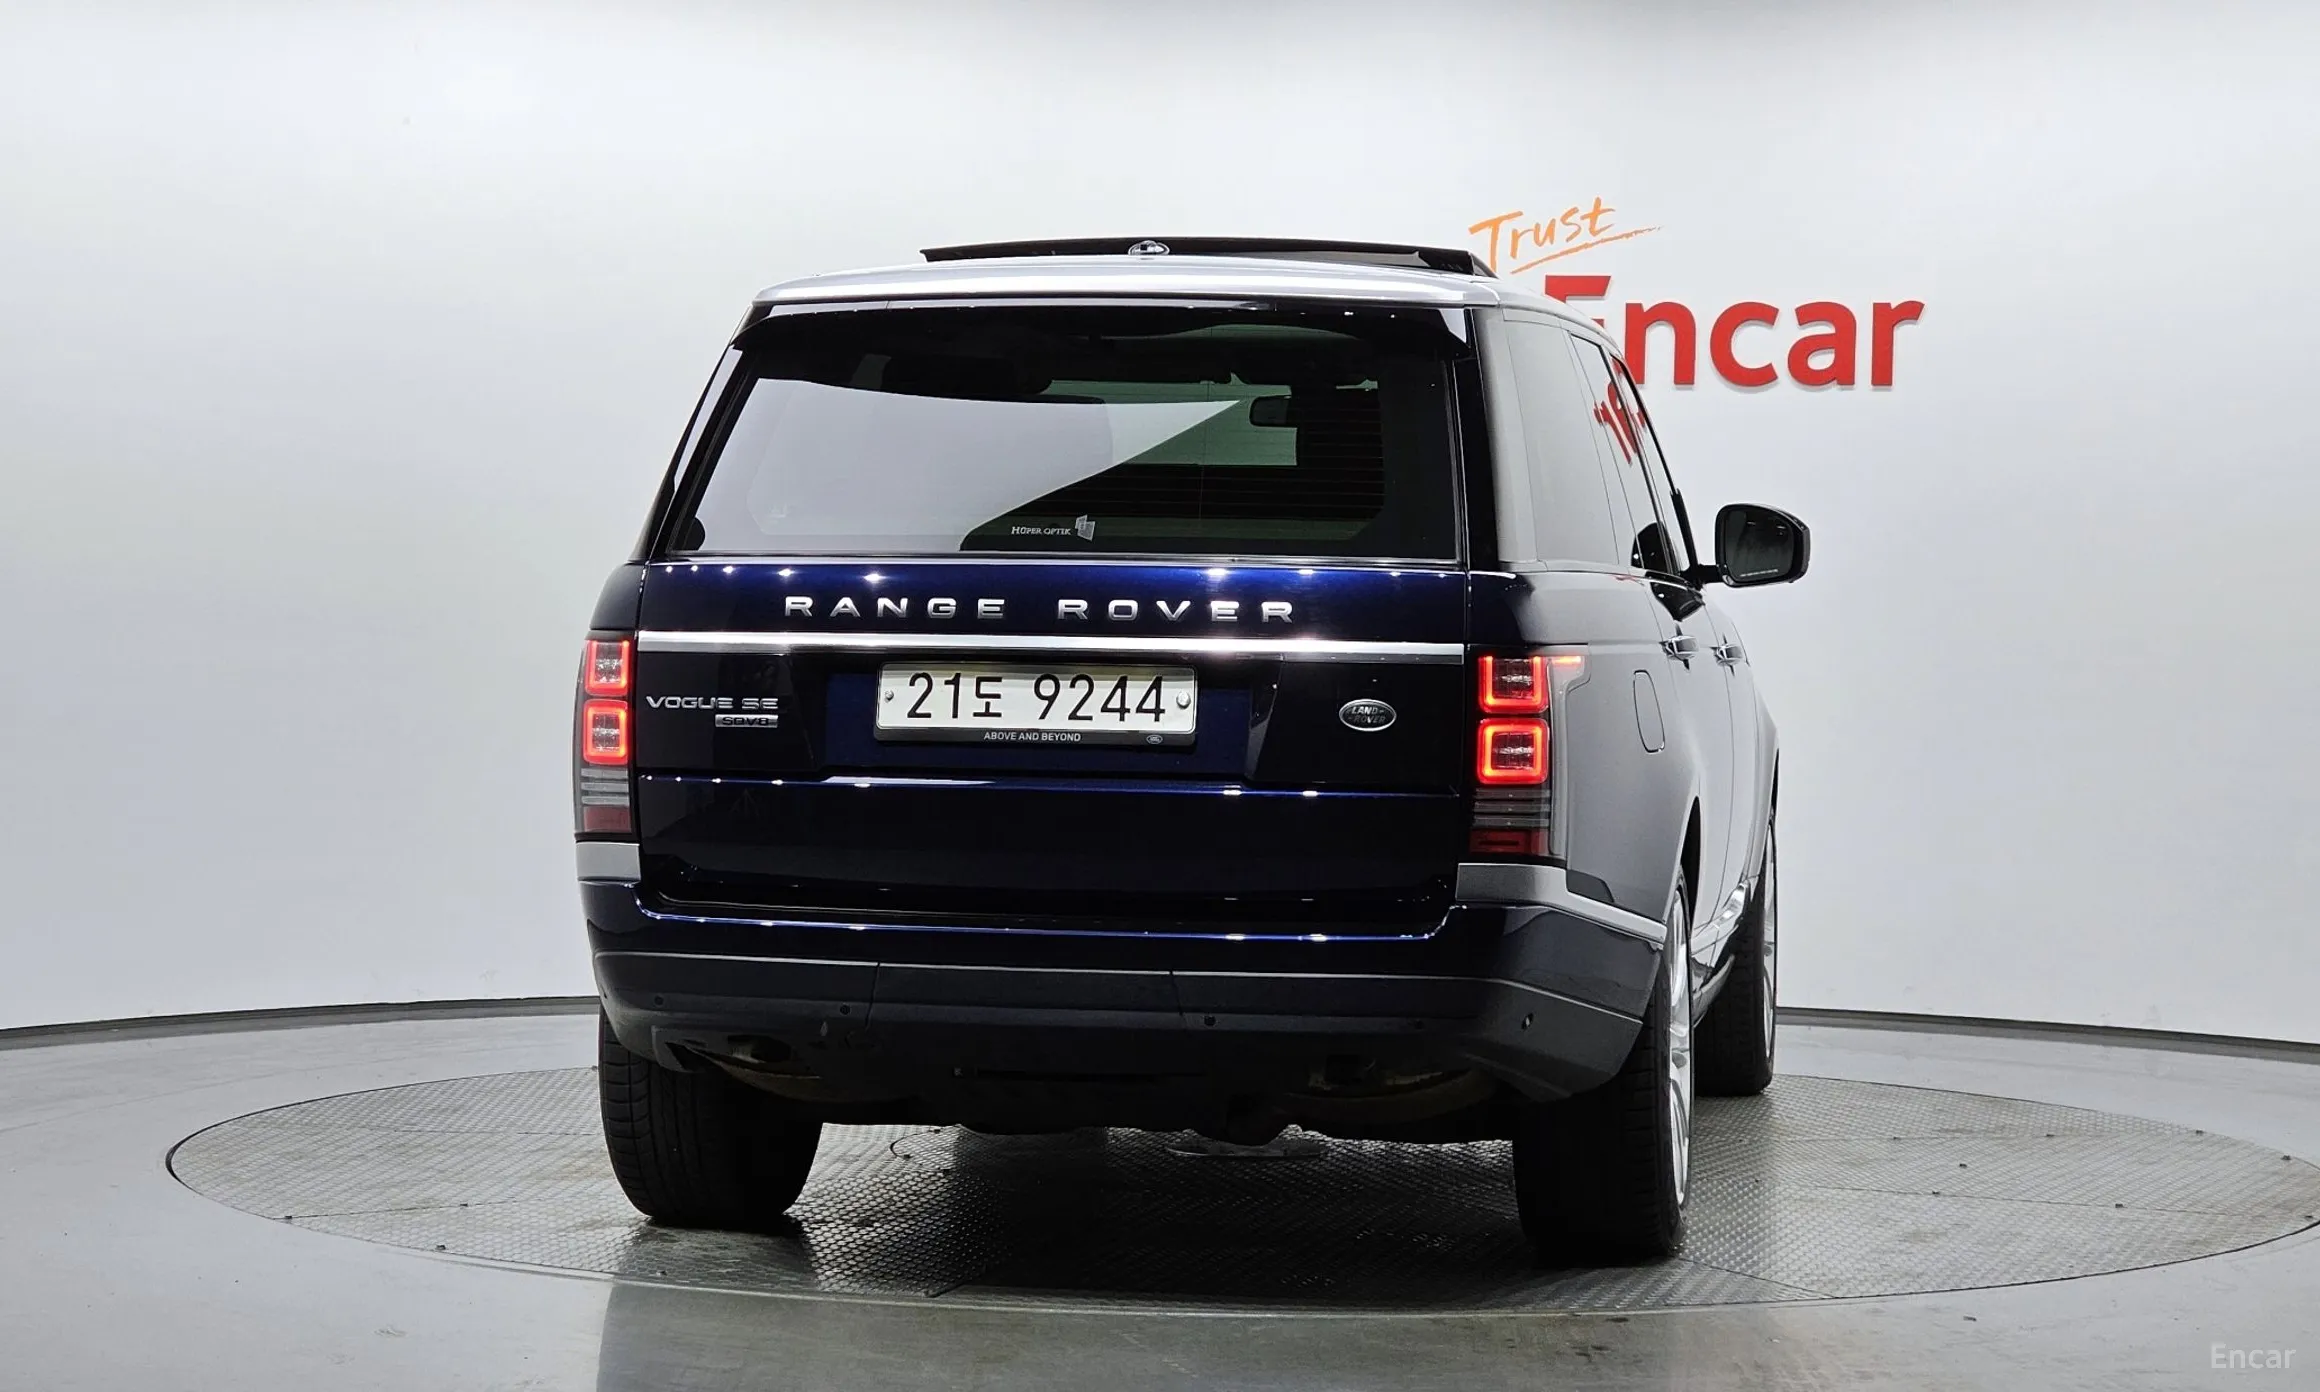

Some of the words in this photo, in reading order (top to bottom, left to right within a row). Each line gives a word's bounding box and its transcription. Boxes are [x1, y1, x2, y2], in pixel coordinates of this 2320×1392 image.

[1469, 197, 1616, 272] Trust
[785, 596, 1005, 619] RANGE
[1057, 599, 1293, 623] ROVER
[646, 695, 734, 709] VOGUE
[741, 698, 779, 709] SE
[907, 672, 1002, 719] 21도
[1033, 673, 1166, 722] 9244
[1351, 706, 1378, 715] LAND
[721, 716, 770, 727] SDV8
[983, 731, 1016, 741] ABOVE
[1018, 732, 1039, 741] AND
[1041, 732, 1081, 742] BEYOND
